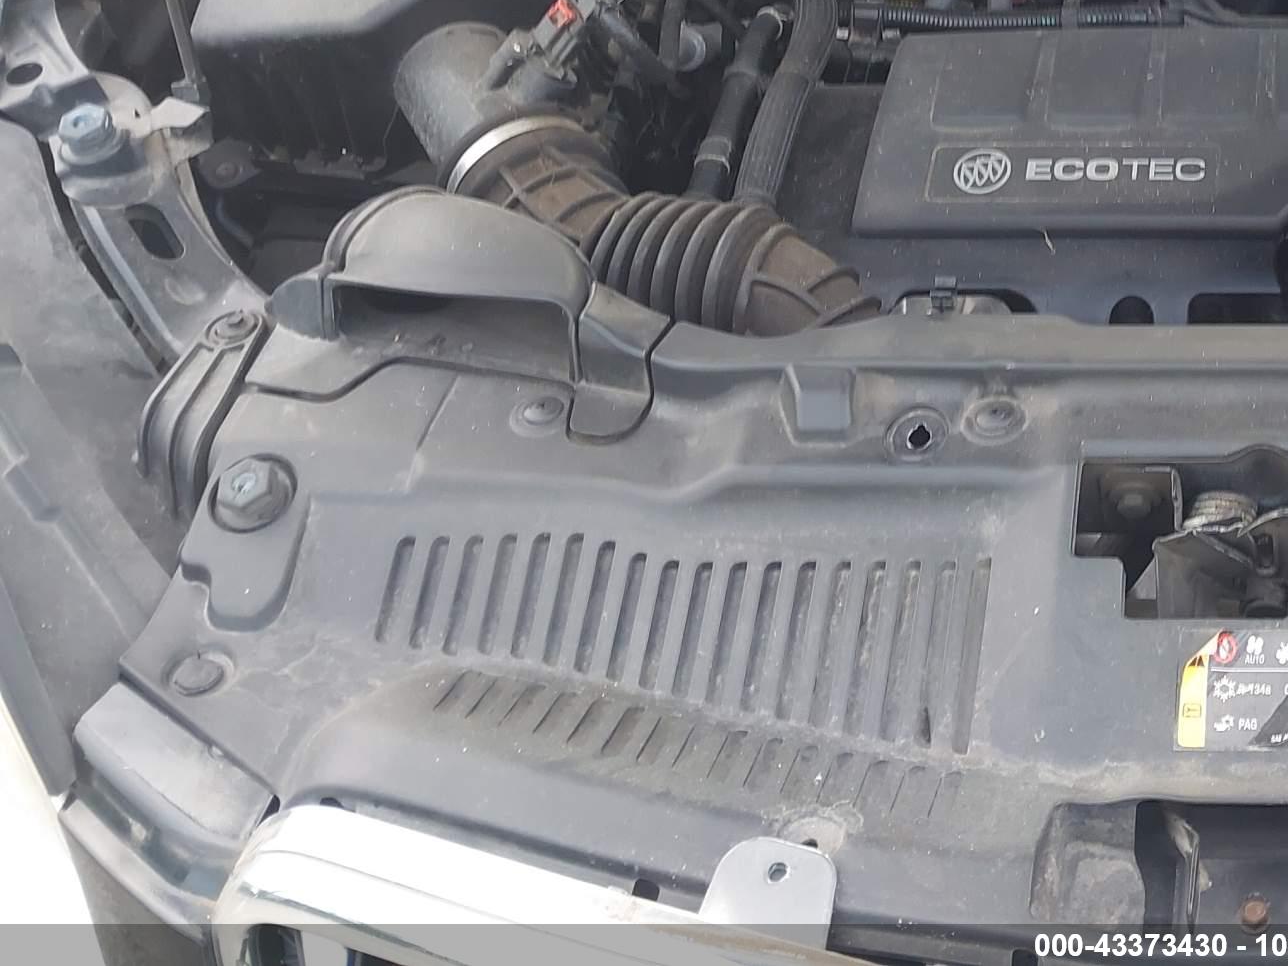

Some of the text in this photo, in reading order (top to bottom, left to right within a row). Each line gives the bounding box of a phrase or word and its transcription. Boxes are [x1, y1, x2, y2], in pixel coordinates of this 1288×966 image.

[1025, 157, 1206, 182] ECOTEC
[1244, 654, 1265, 665] AUTO
[1238, 717, 1258, 731] PAG
